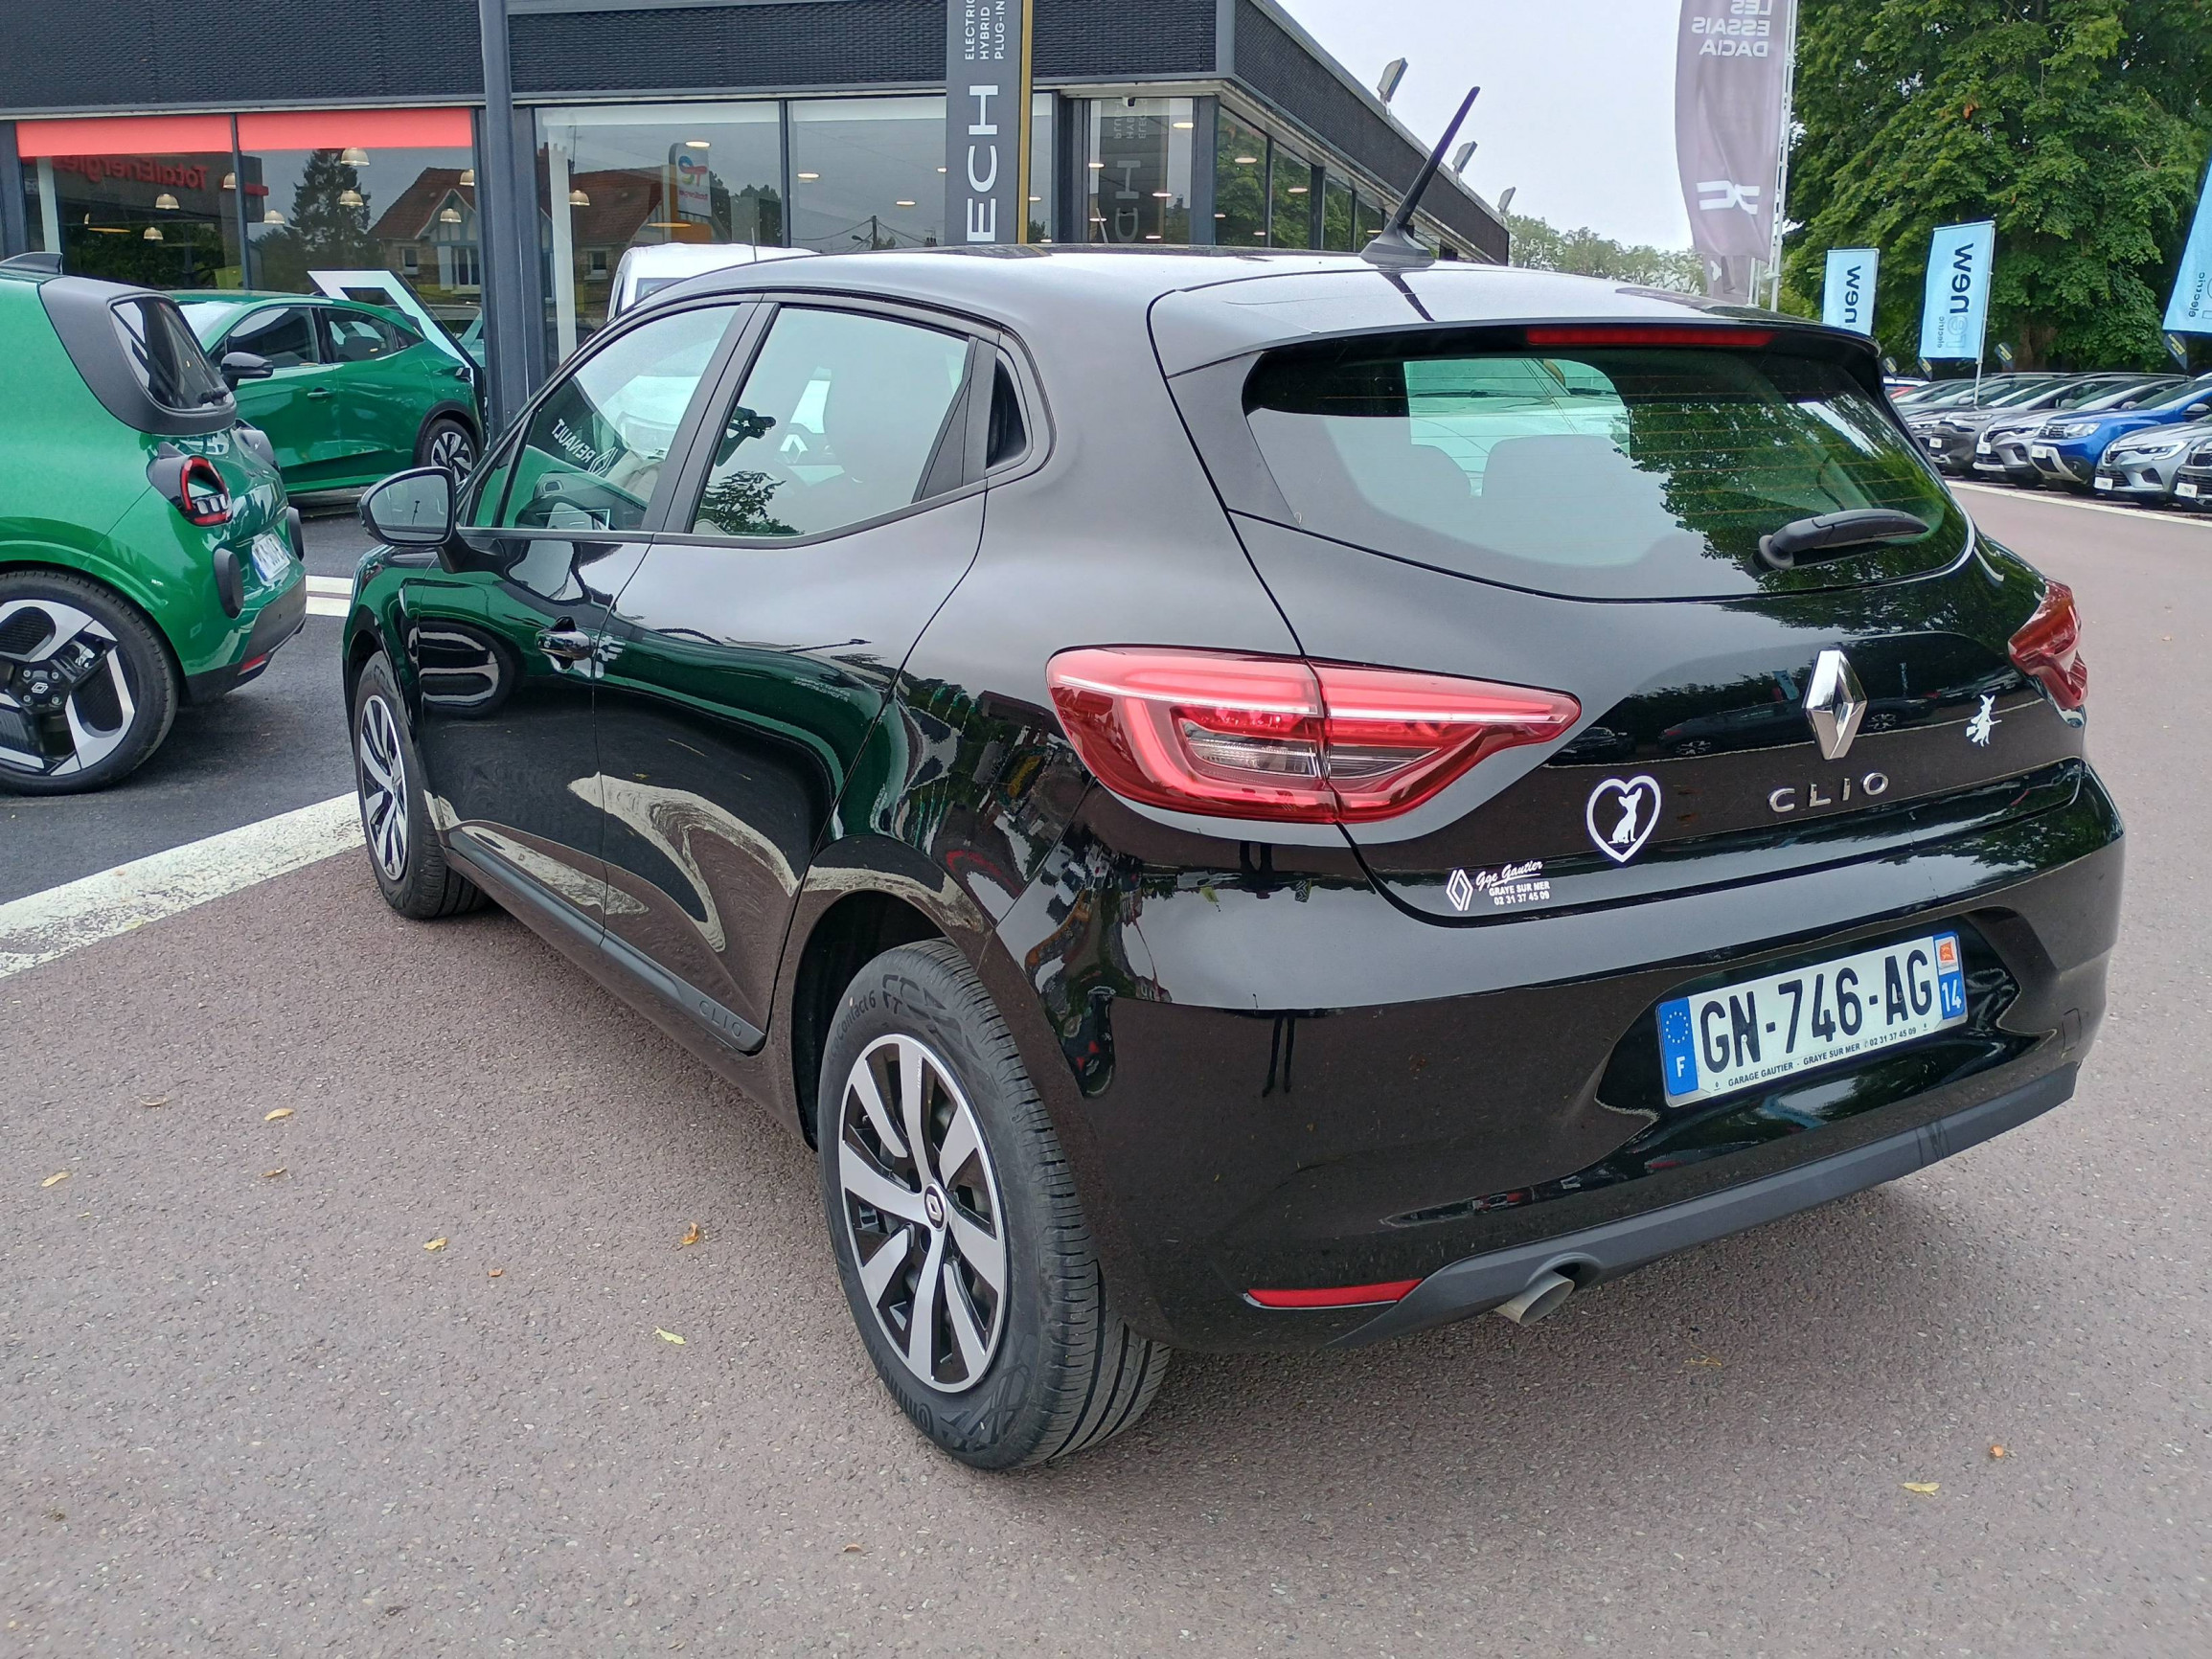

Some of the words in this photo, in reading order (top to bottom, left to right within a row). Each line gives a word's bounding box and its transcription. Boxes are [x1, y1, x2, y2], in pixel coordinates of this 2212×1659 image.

[979, 7, 991, 60] HYBRID
[994, 0, 1006, 59] PLUG-IN
[1768, 772, 1889, 813] CLIO
[1489, 884, 1516, 897] GRAYE
[1516, 882, 1533, 894] SUR
[1533, 880, 1550, 891] MER
[1501, 860, 1543, 884] Gautier
[1494, 896, 1505, 905] 02
[1505, 894, 1516, 904] 31
[1517, 893, 1527, 902] 37
[1528, 891, 1539, 901] 45
[1539, 890, 1550, 899] 09
[1699, 949, 1933, 1074] GN-746-AG
[1941, 979, 1962, 1012] 14
[698, 1000, 742, 1039] CLIO
[1676, 1057, 1686, 1078] F
[1728, 1071, 1760, 1087] GARAGE
[1761, 1061, 1794, 1078] GAUTIER
[1803, 1052, 1828, 1065] GRAYE
[1829, 1048, 1844, 1058] SUR
[1845, 1042, 1860, 1054] MER
[1869, 1037, 1879, 1047] 02
[1880, 1034, 1888, 1044] 31
[1889, 1032, 1898, 1041] 37
[1899, 1029, 1907, 1037] 45
[1907, 1027, 1917, 1035] 09
